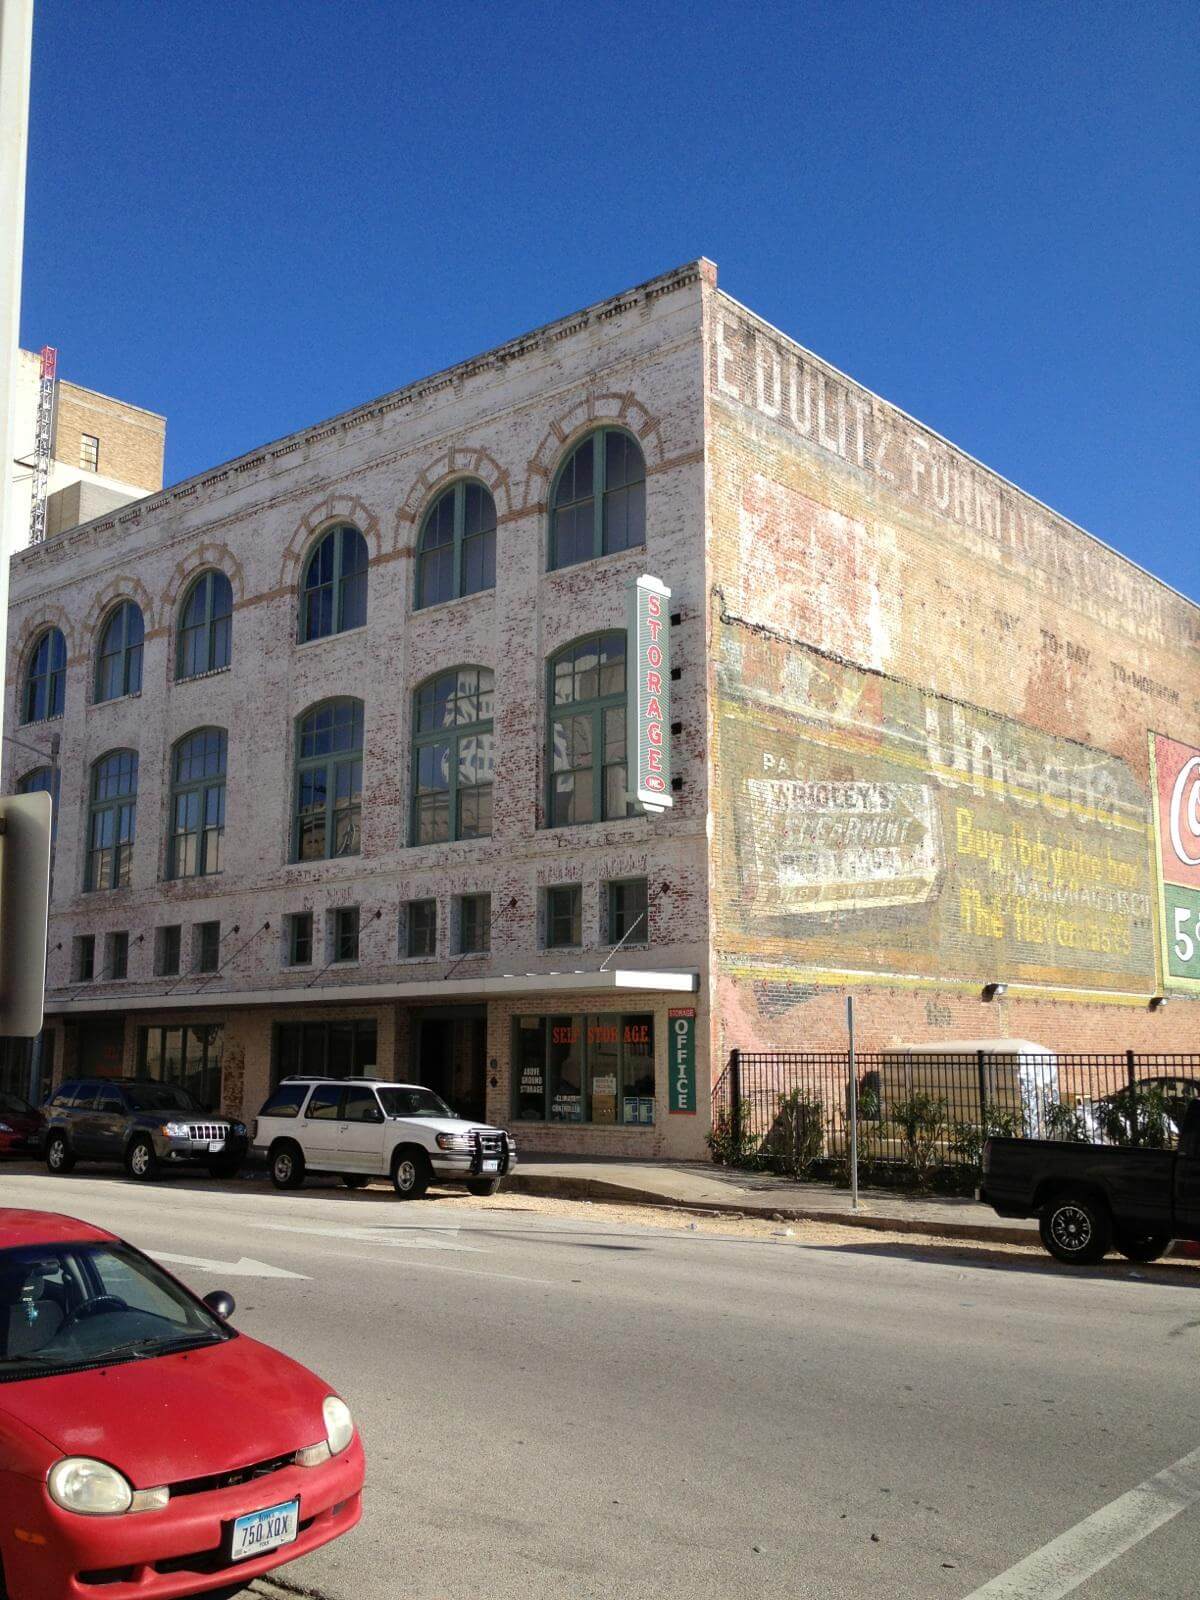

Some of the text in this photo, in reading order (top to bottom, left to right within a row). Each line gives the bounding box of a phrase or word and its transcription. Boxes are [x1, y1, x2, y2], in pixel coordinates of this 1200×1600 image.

[646, 595, 663, 771] STORAGE
[673, 1019, 690, 1110] OFFICE
[241, 1515, 288, 1547] 750 XQX
